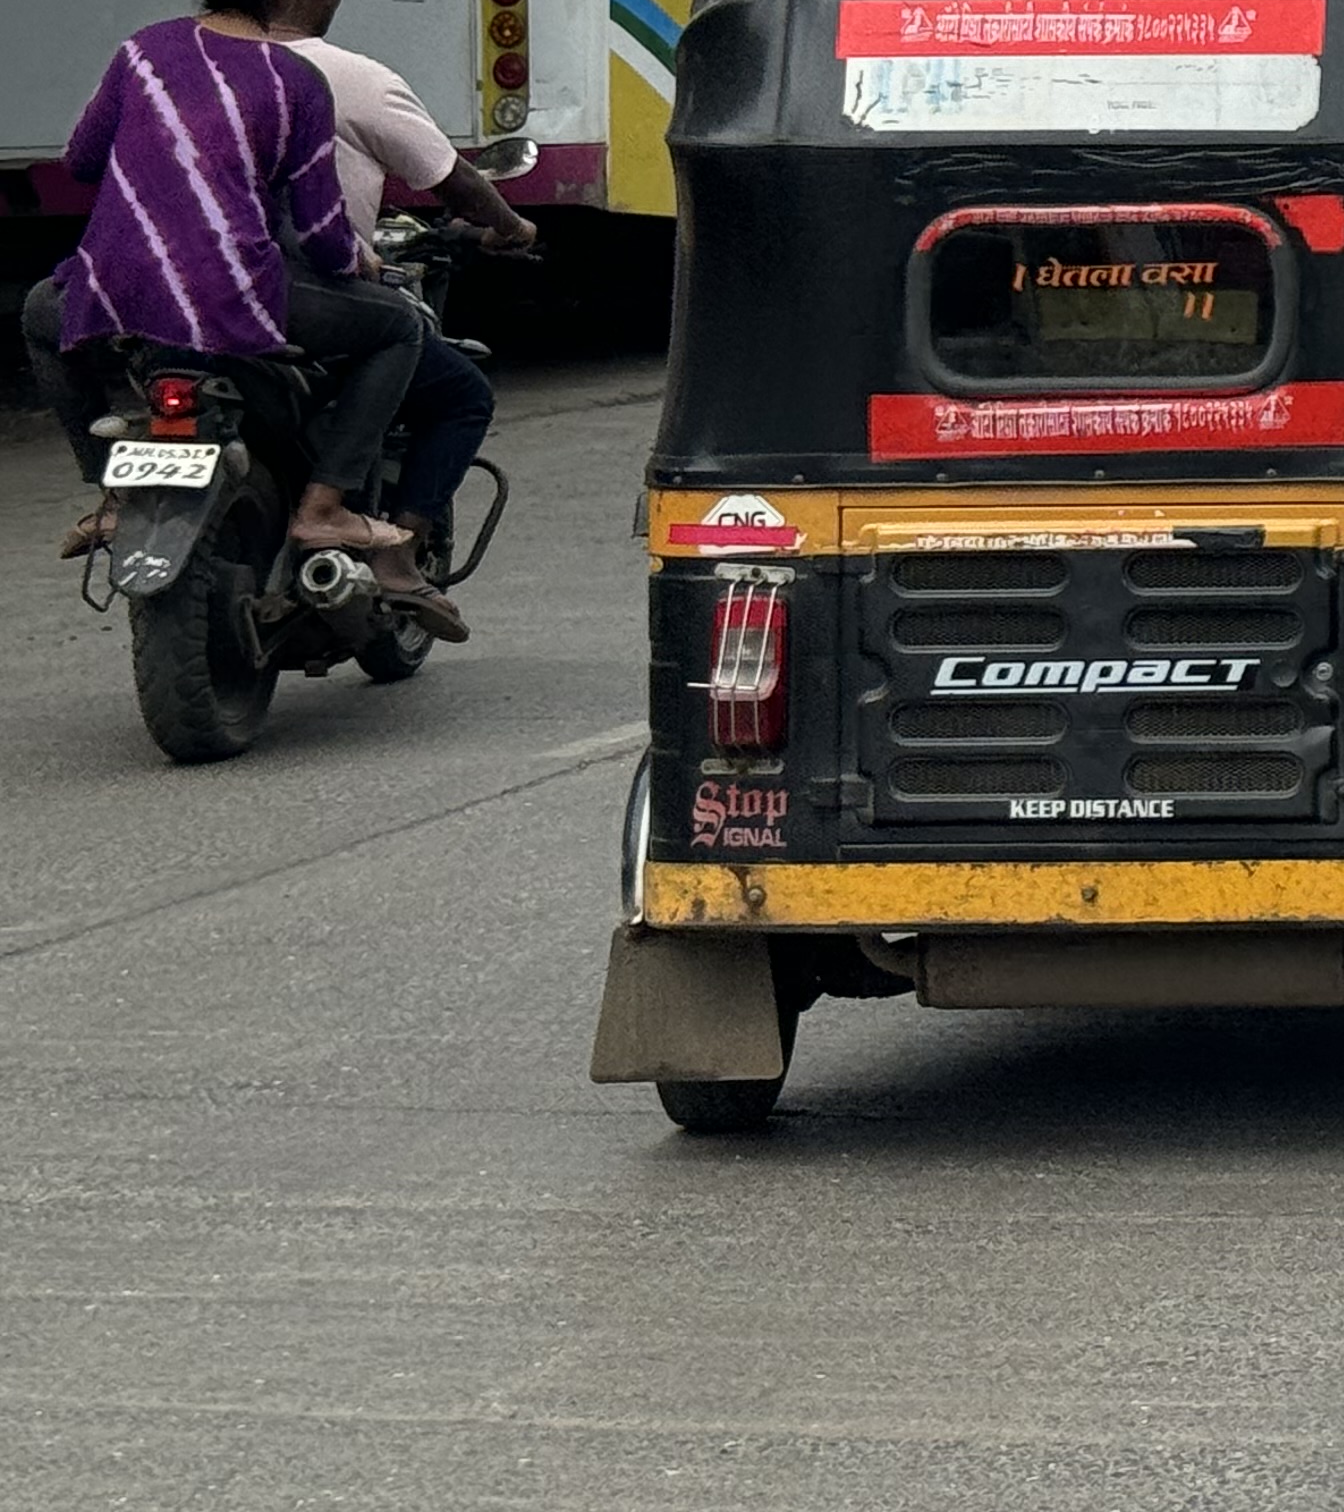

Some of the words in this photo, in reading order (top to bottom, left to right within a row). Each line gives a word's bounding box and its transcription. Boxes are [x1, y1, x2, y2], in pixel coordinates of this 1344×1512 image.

[1036, 256, 1136, 287] घेतला
[1141, 261, 1219, 284] वसा
[112, 461, 208, 481] 0942
[690, 781, 790, 848] Stop
[1009, 799, 1066, 819] KEEP
[1069, 799, 1174, 819] DISTANCE
